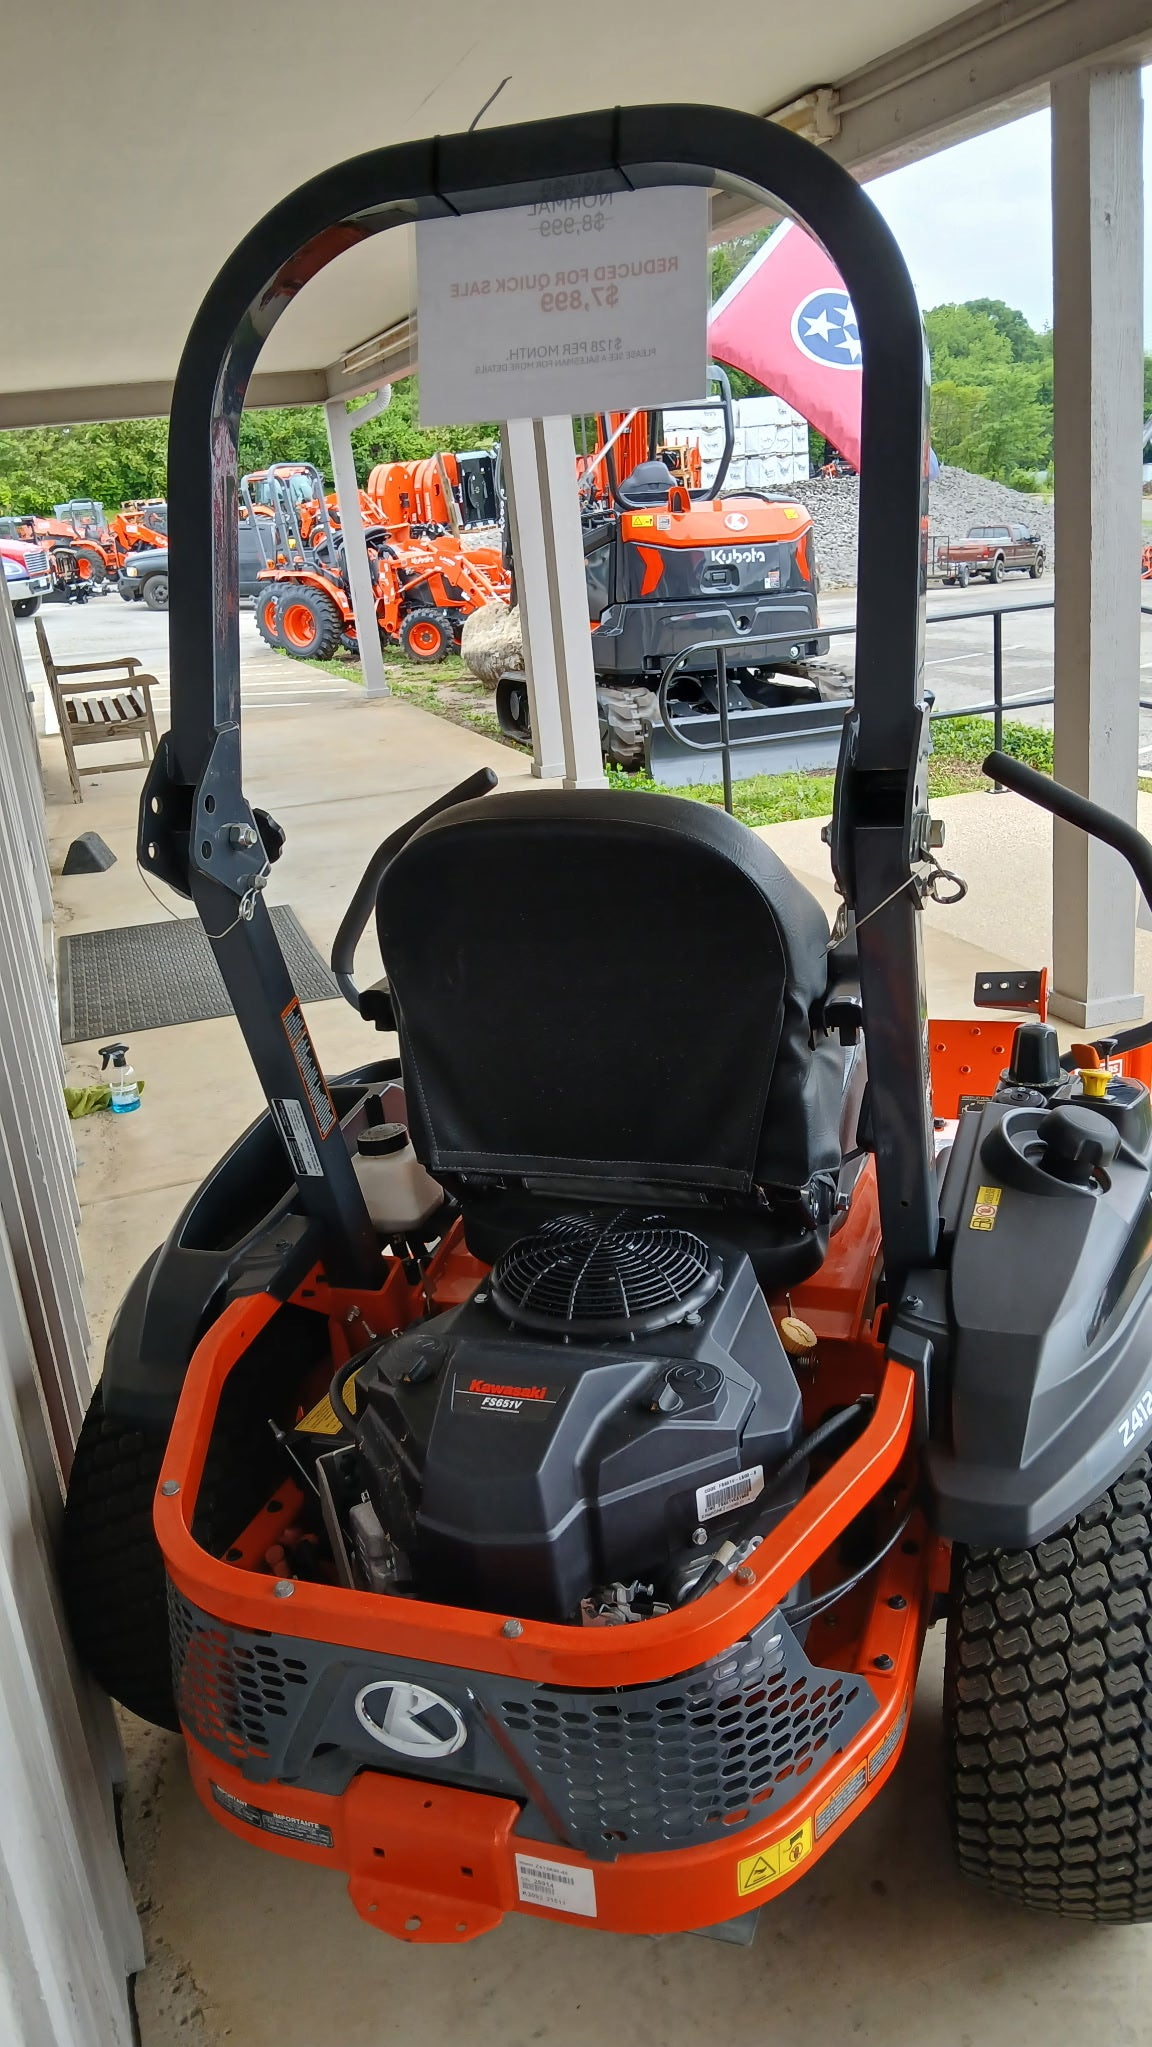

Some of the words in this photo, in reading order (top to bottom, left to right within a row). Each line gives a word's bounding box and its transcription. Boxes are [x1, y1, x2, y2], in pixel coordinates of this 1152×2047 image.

[711, 547, 766, 564] Kubota
[468, 1379, 548, 1400] Kawasaki
[481, 1397, 523, 1409] FS651V
[272, 1812, 320, 1829] IMPORTANTE
